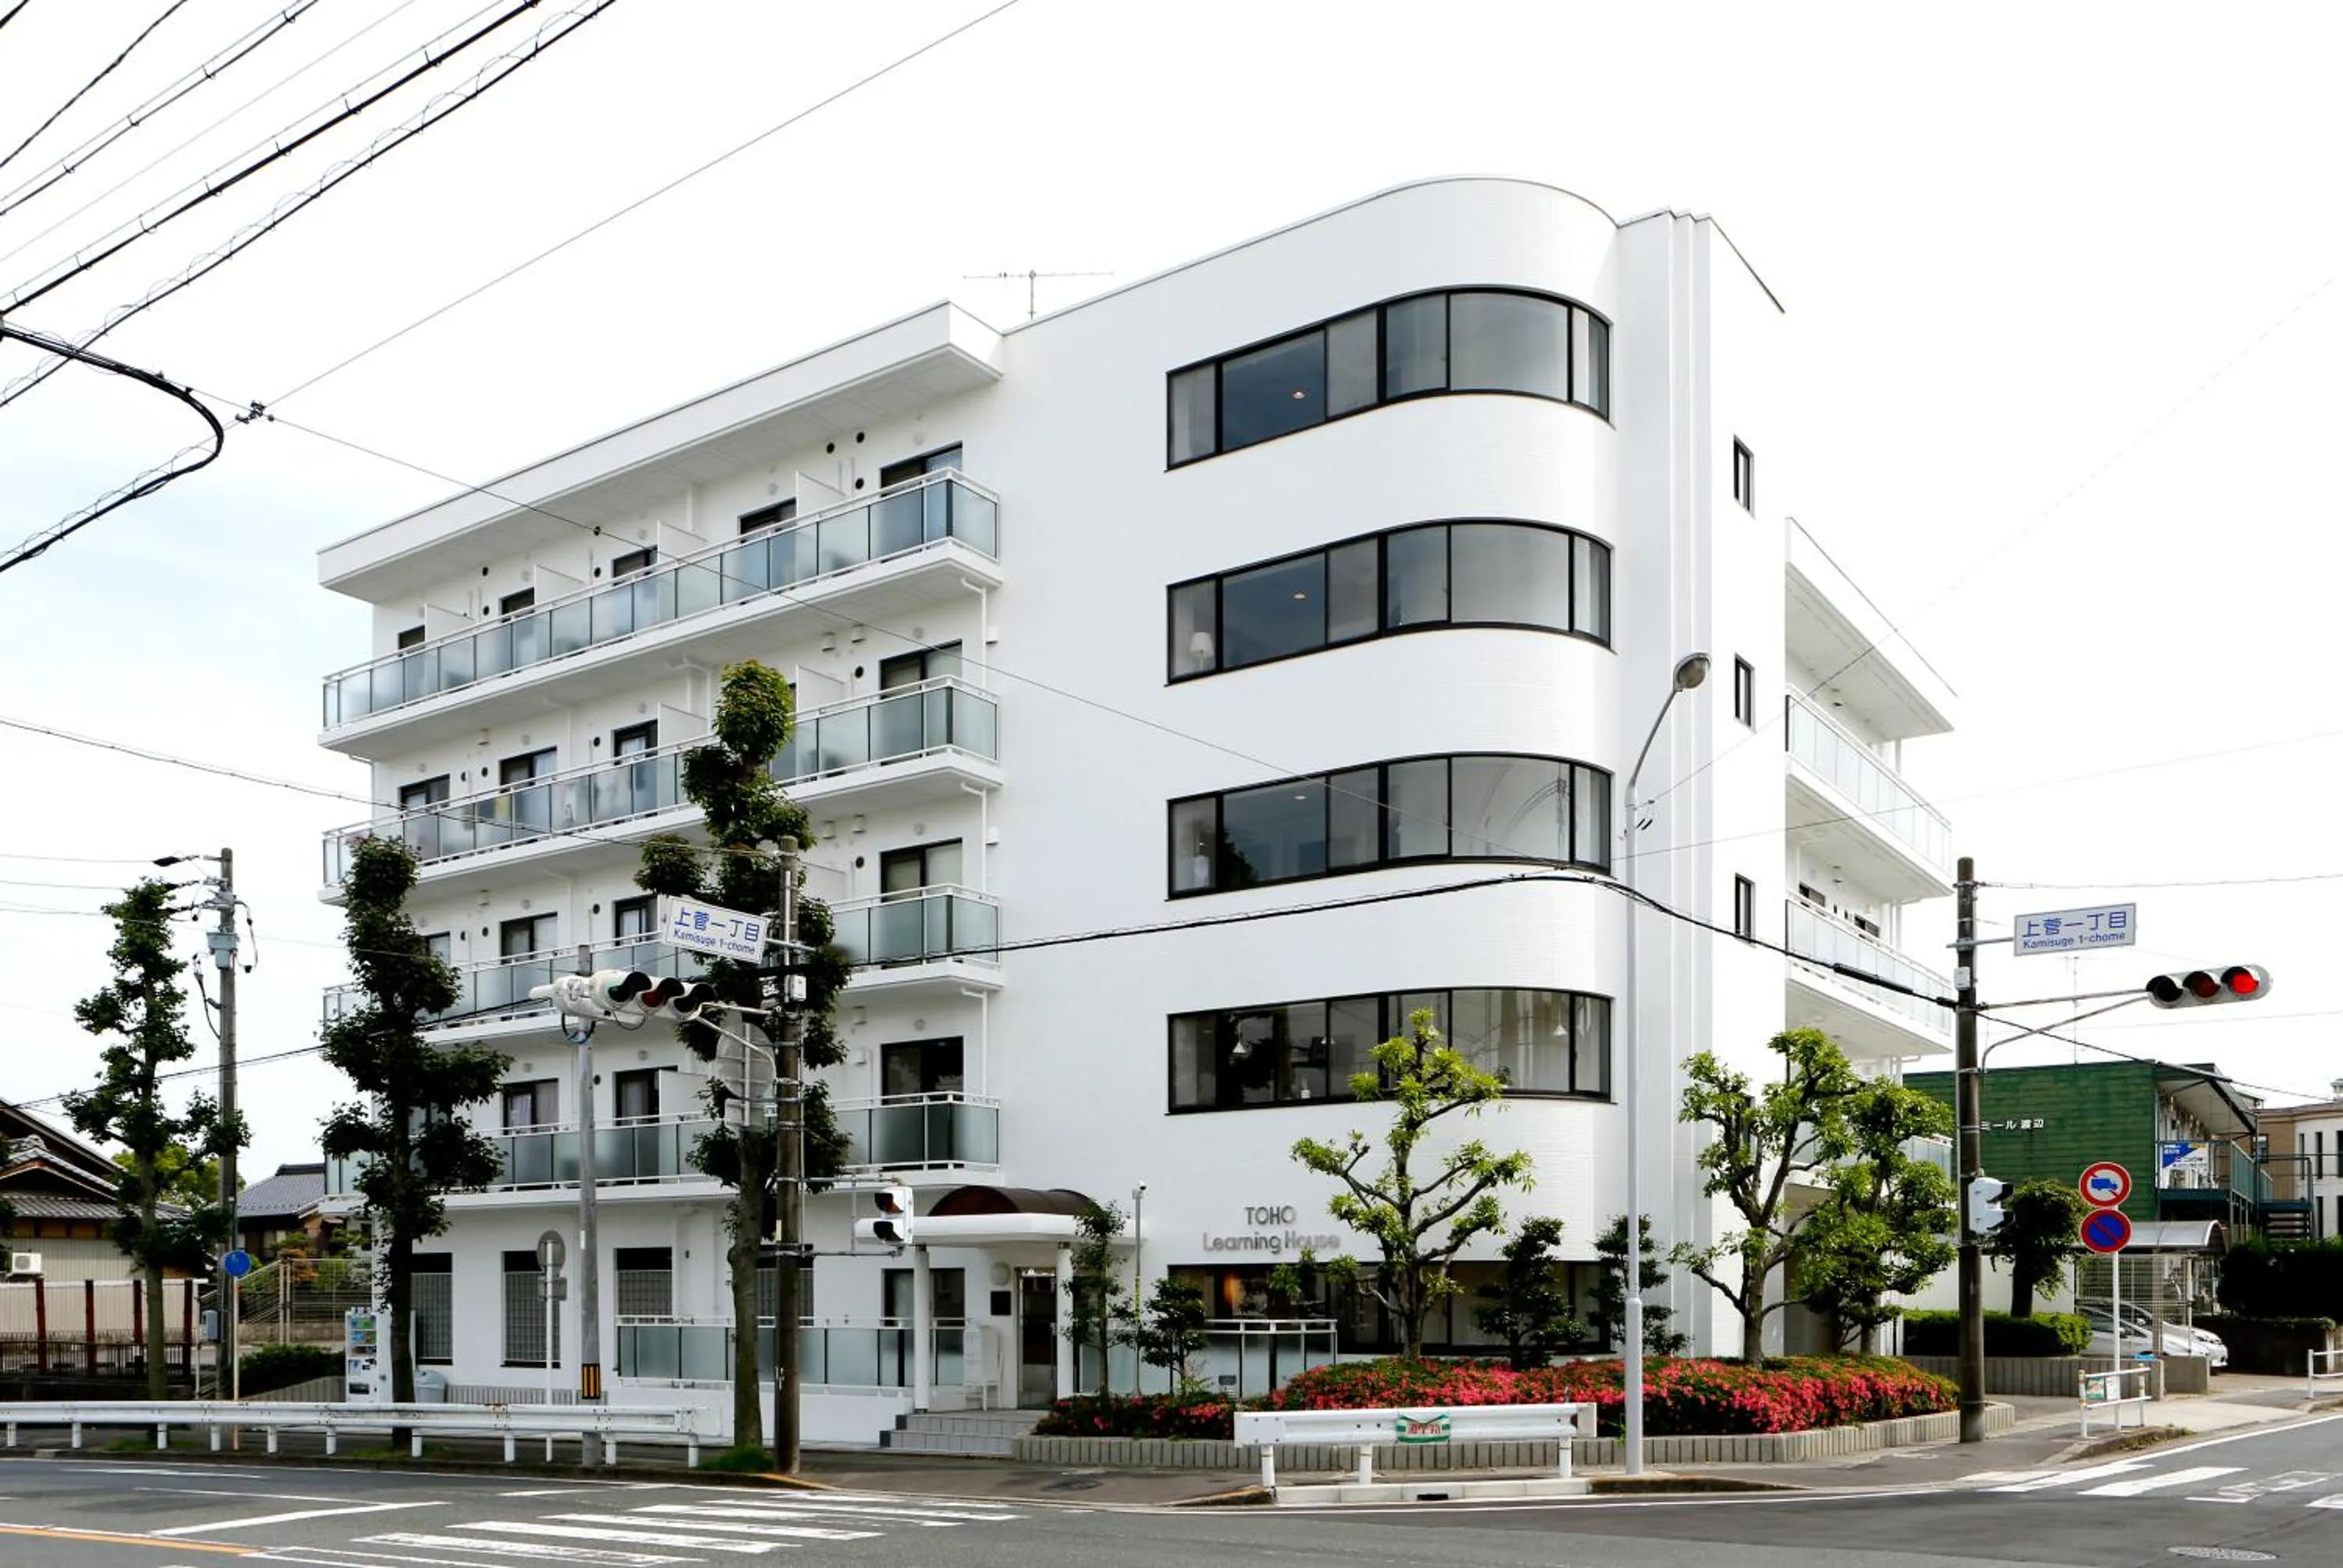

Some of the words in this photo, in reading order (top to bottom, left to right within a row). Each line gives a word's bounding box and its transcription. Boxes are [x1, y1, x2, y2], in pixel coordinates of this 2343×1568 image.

[675, 907, 760, 943] 上菅一丁目
[2022, 911, 2126, 938] 上菅一丁目
[674, 928, 716, 947] Kamisuge
[719, 939, 755, 955] 1-chome
[2023, 937, 2075, 950] Kamisuge
[2079, 932, 2125, 944] 1-chome
[1245, 1205, 1297, 1226] TOHO
[1203, 1230, 1282, 1254] Learning
[1284, 1230, 1341, 1249] House
